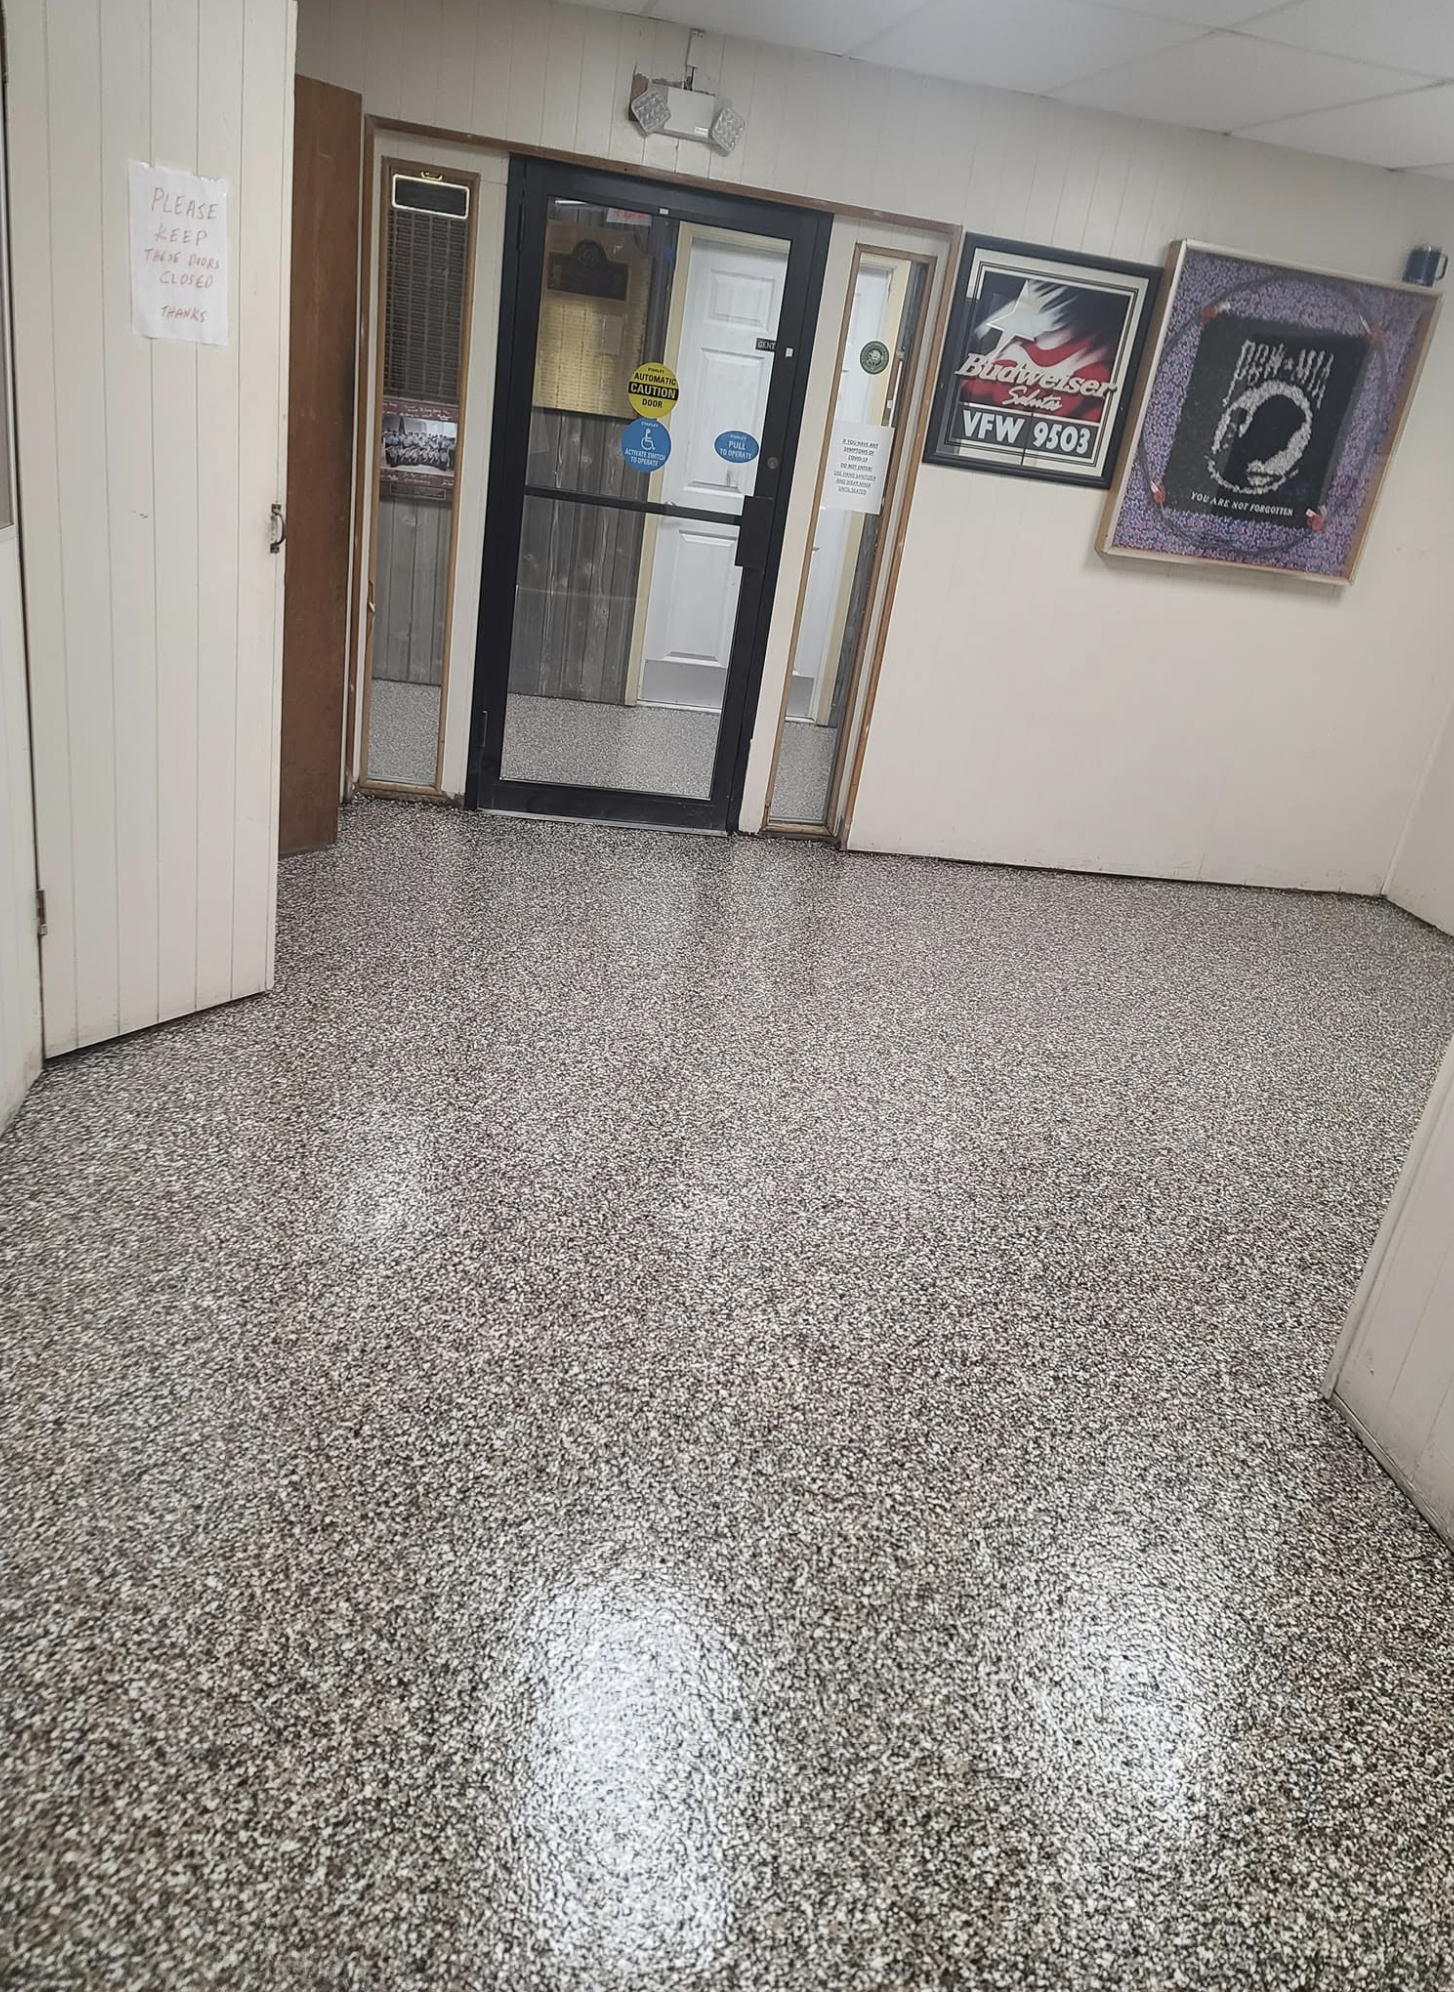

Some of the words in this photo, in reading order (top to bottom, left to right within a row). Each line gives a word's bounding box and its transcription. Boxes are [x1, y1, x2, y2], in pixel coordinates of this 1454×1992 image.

[151, 187, 218, 220] PLEASE
[154, 223, 208, 246] KEEP
[188, 253, 220, 269] DOORS
[159, 271, 214, 289] CLOSED
[161, 305, 207, 323] THANKS
[634, 372, 676, 386] AUTOMATIC
[955, 352, 1117, 398] Budweiser
[630, 382, 676, 399] CAUTION
[642, 398, 663, 409] DOOR
[963, 409, 1025, 443] VFW
[1033, 422, 1091, 454] 9503
[729, 440, 746, 450] PULL
[625, 448, 647, 458] ACTIVATE
[647, 452, 666, 461] SWITCH
[631, 456, 637, 464] TO
[638, 457, 658, 466] OPERATE
[720, 448, 727, 456] TO
[728, 450, 752, 460] OPERATE
[1190, 490, 1210, 503] YOU
[1210, 497, 1231, 508] ARE
[1231, 501, 1248, 511] NOT
[1249, 504, 1294, 516] FORGOTTEN
